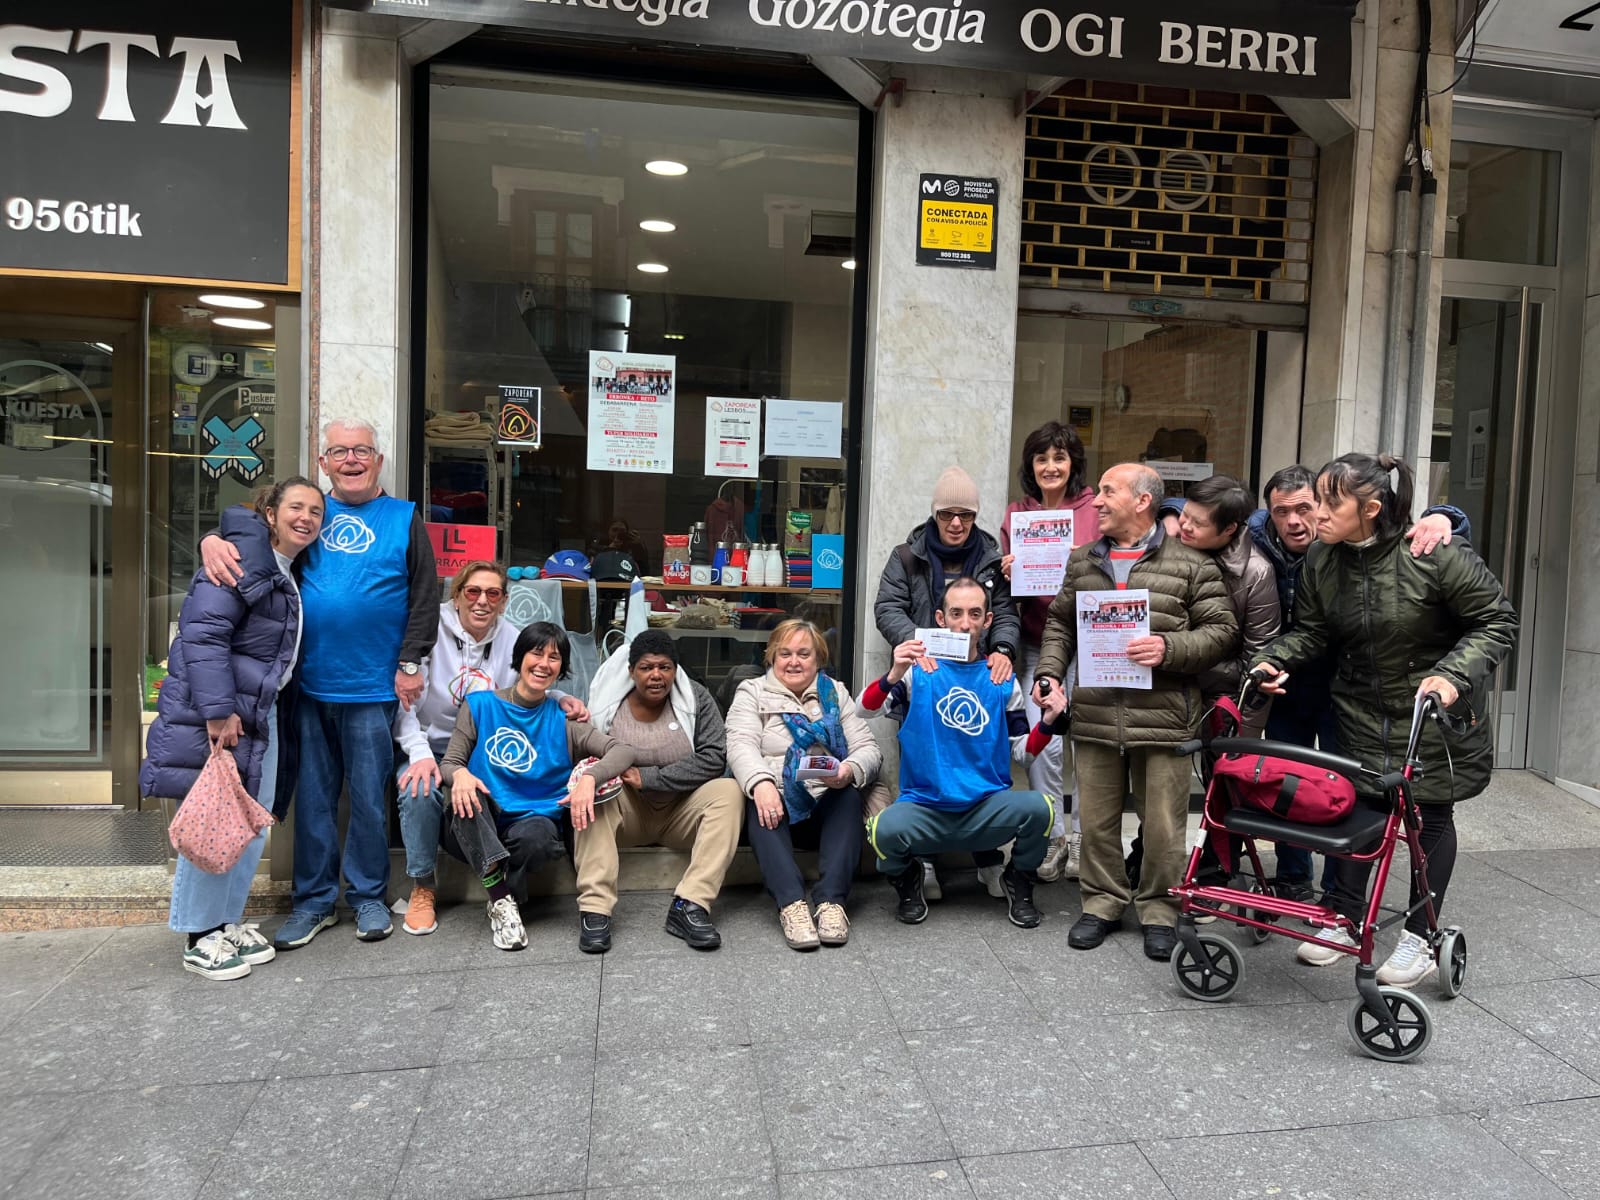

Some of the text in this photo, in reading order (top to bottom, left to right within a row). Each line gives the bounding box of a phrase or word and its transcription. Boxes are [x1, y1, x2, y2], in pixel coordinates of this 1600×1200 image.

[748, 0, 985, 52] Gozotegia
[1020, 8, 1125, 58] OGI
[1158, 21, 1318, 76] BERRI
[963, 186, 994, 194] PROSEGUR
[926, 208, 988, 220] CONECTADA
